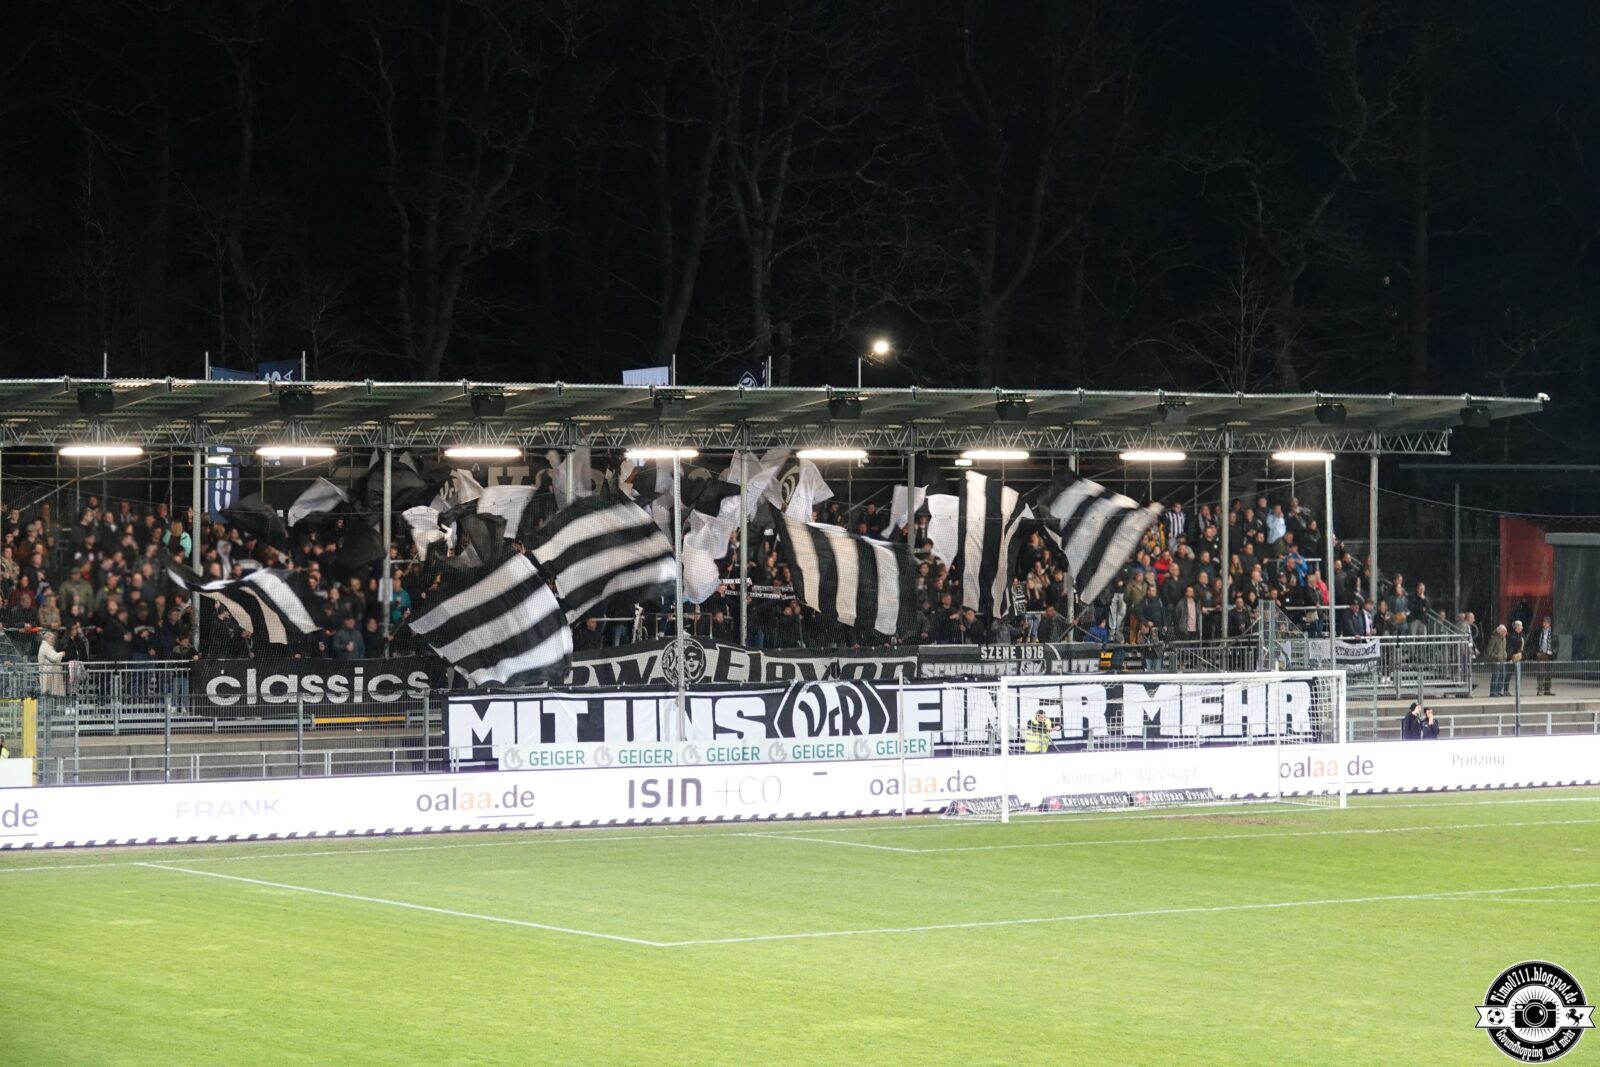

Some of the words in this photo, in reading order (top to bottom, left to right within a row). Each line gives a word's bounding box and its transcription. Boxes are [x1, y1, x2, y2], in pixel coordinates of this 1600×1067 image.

[980, 645, 1017, 660] SZENE
[206, 667, 430, 705] classics
[448, 699, 589, 760] MIT
[603, 694, 767, 743] UNS
[897, 684, 1109, 744] EINER
[1122, 680, 1313, 737] MEHR
[529, 749, 586, 767] GEIGER
[618, 748, 674, 765] GEIGER
[706, 746, 761, 763] GEIGER
[792, 743, 846, 761] GEIGER
[1279, 754, 1374, 780] oalaade
[416, 784, 536, 812] oalaa.de
[175, 797, 282, 820] FRANK
